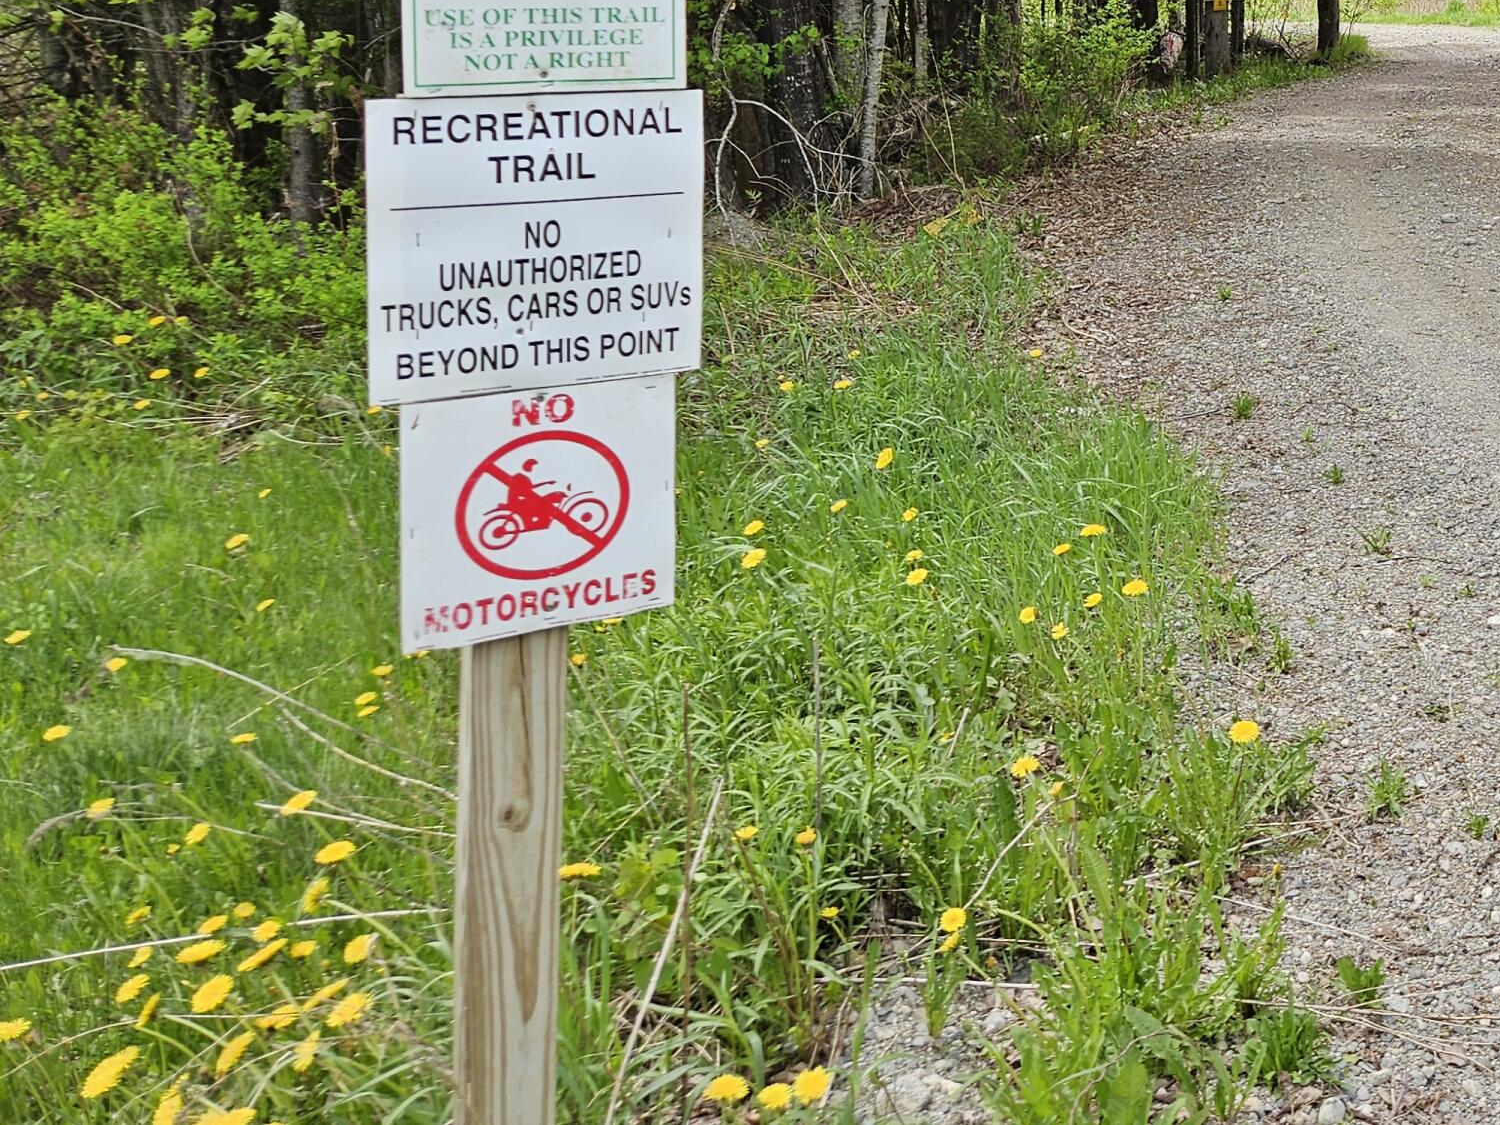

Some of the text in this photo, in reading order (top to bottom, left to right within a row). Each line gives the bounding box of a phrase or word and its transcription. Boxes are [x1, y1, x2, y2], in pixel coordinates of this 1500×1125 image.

[424, 6, 666, 27] USE OF THIS TRAIL
[449, 28, 644, 49] IS A PRIVILEGE
[464, 50, 631, 72] NOT A RIGHT
[392, 106, 682, 145] RECREATIONAL
[487, 152, 596, 184] TRAIL
[524, 219, 561, 249] NO
[439, 249, 641, 292] UNAUTHORIZED
[381, 281, 691, 332] TRUCKS, CARS OR SUVs
[396, 327, 680, 380] BEYOND THIS POINT
[511, 393, 575, 426] NO
[423, 568, 657, 635] MOTORCYCLES
